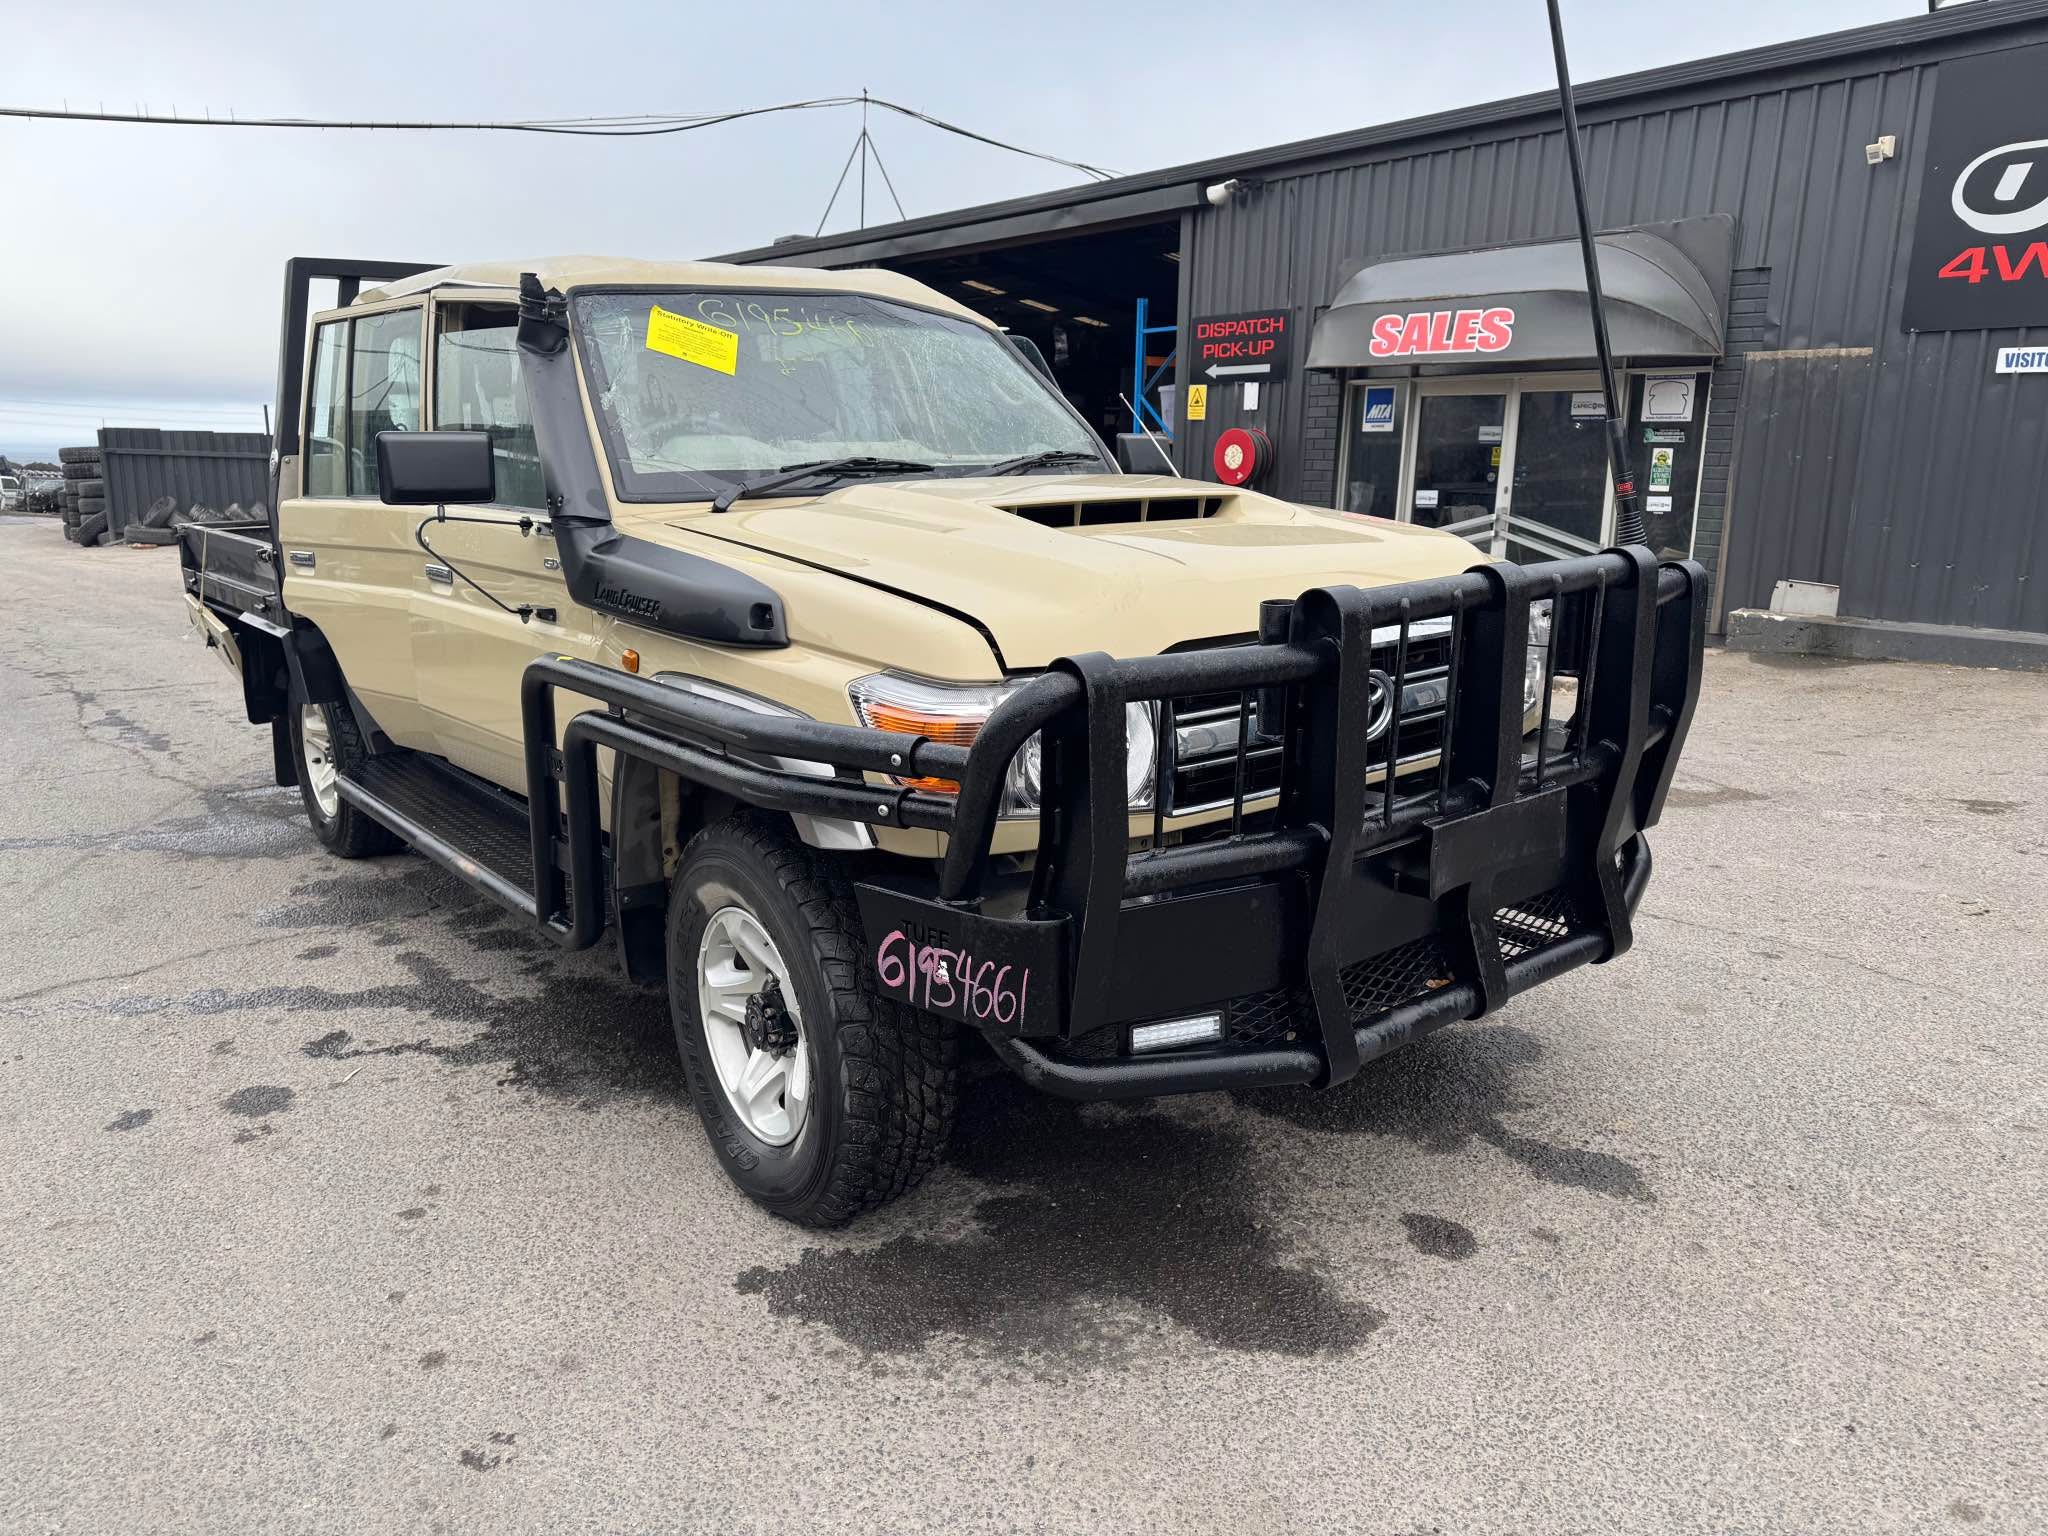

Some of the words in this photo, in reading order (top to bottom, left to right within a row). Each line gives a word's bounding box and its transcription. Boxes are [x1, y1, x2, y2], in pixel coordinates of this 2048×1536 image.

[656, 310, 694, 328] Statutory
[696, 323, 733, 340] Write-Off
[1197, 317, 1285, 339] DISPATCH
[1370, 308, 1515, 357] SALES
[1203, 340, 1275, 359] PICK-UP
[1367, 404, 1392, 419] MTA
[877, 930, 1029, 1030] 61954661
